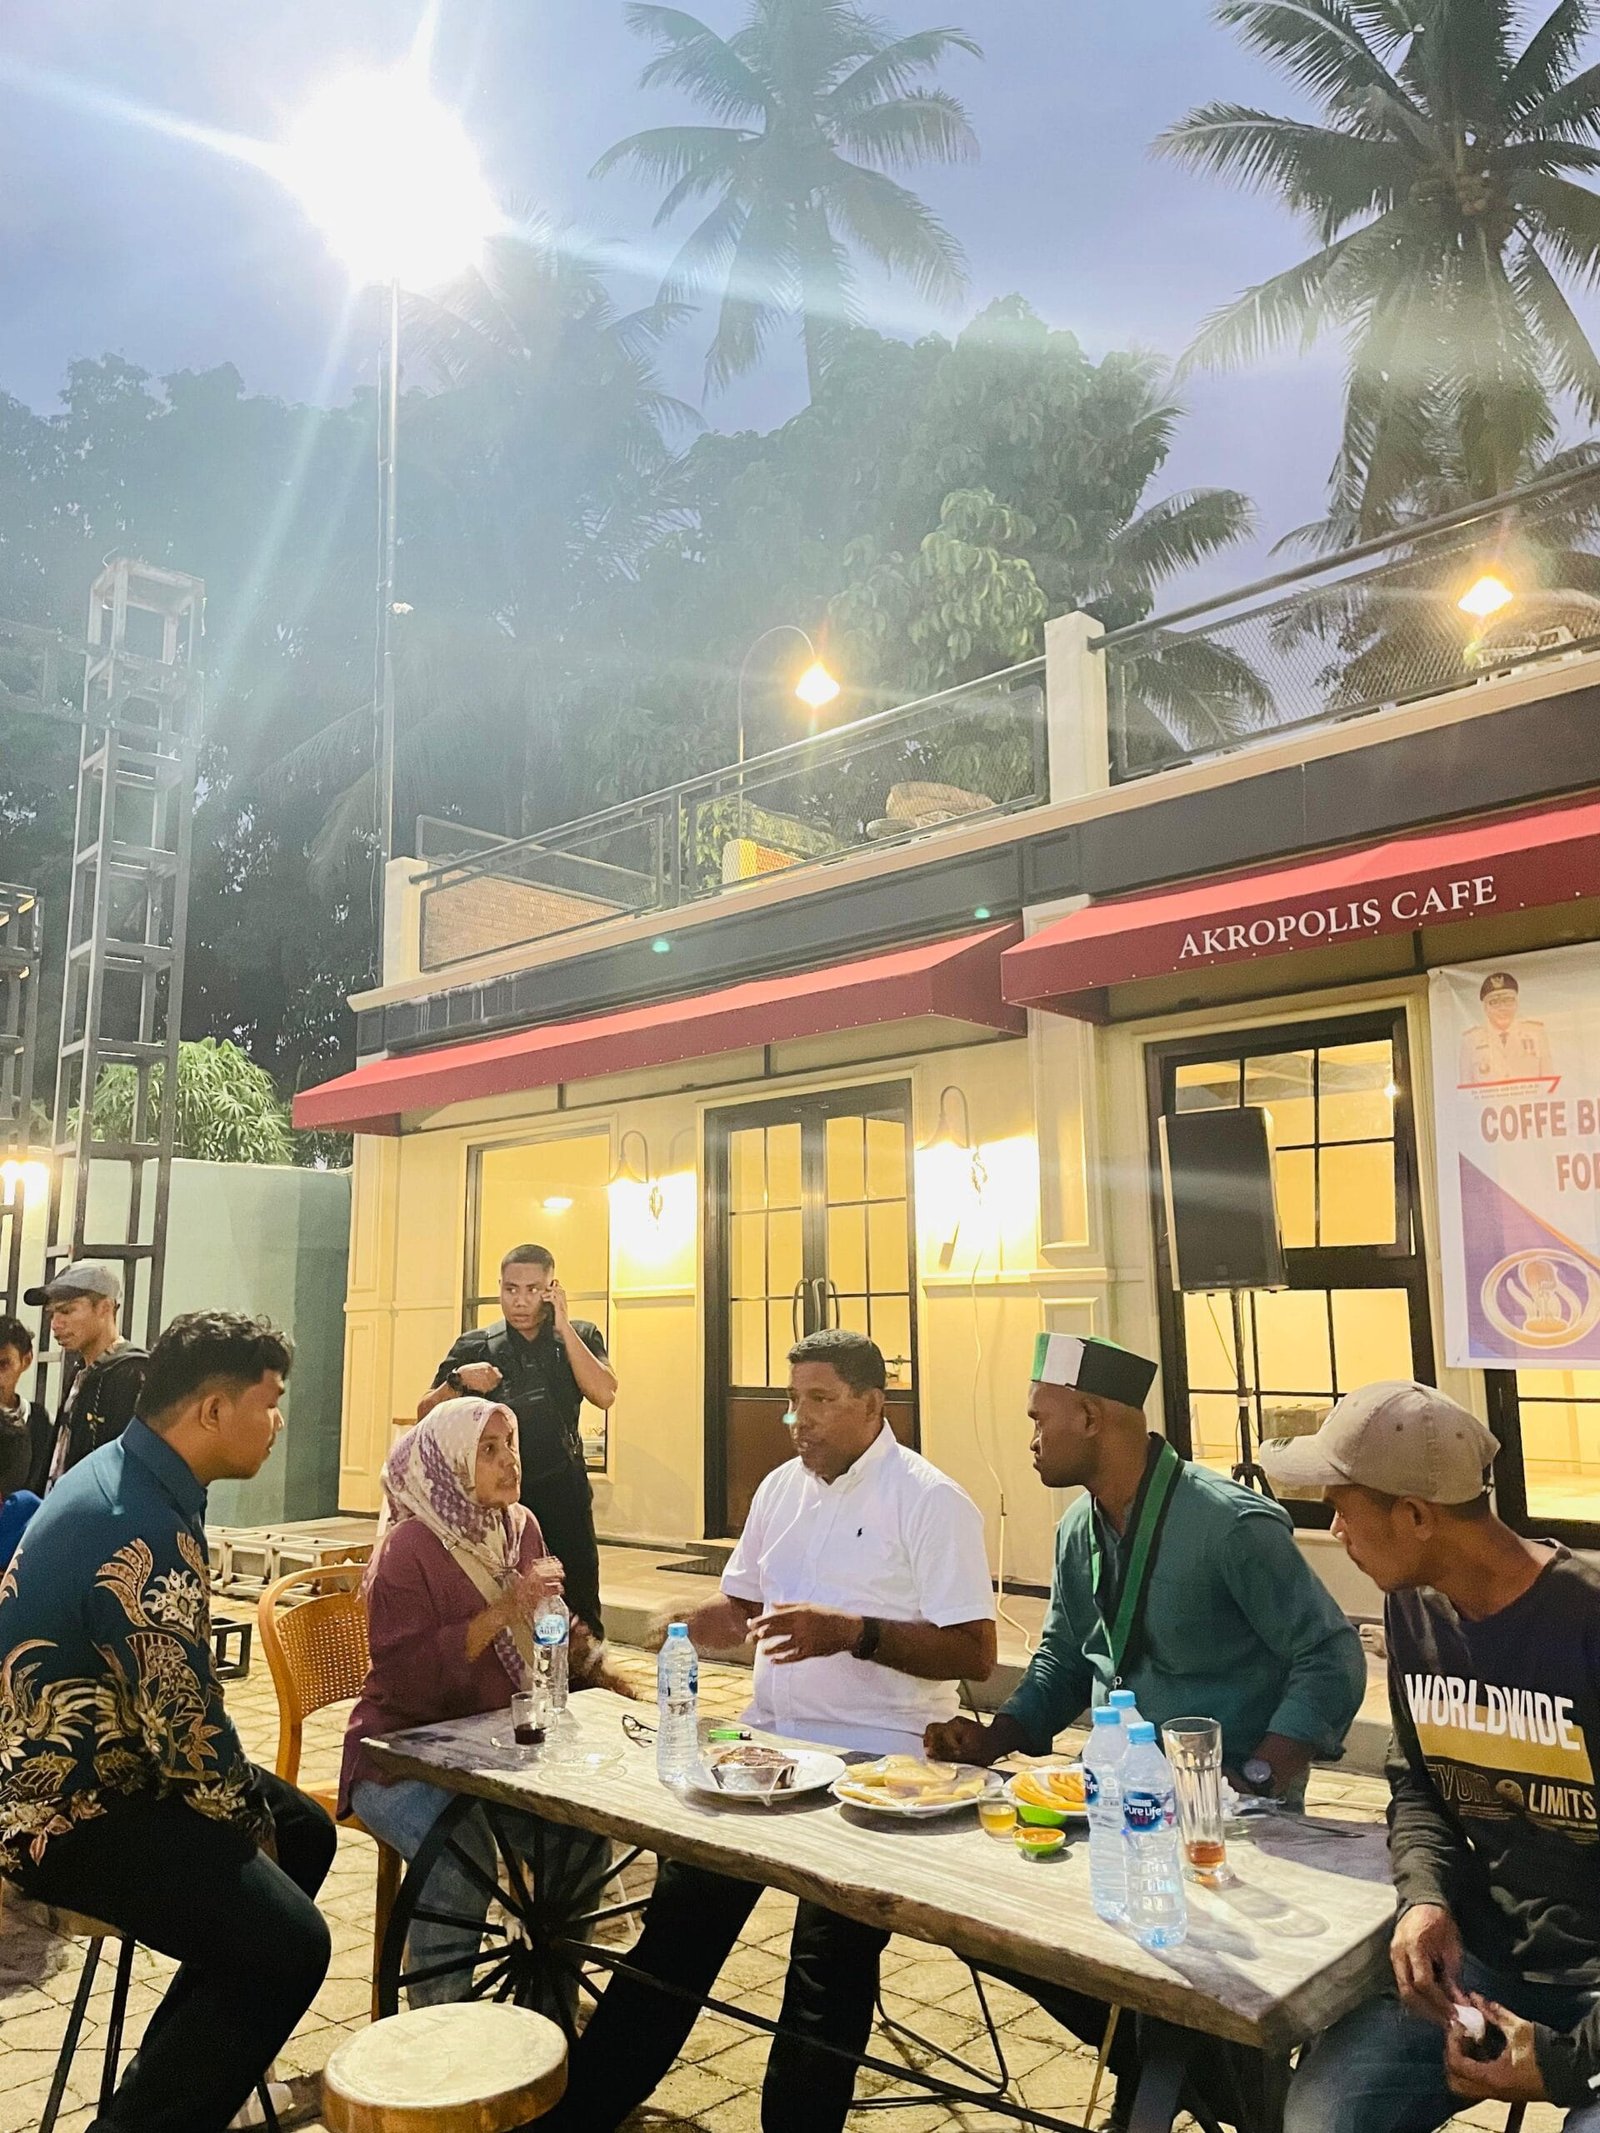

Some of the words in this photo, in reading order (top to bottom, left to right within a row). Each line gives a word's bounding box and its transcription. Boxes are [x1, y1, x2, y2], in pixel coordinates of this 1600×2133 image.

[1179, 898, 1381, 959] AKROPOLIS
[1391, 875, 1497, 919] CAFE
[1480, 1100, 1567, 1143] COFFE
[1577, 1098, 1600, 1135] B
[1404, 1673, 1581, 1750] WORLDWIDE
[1123, 1803, 1144, 1816] Pure
[1144, 1806, 1162, 1820] Life
[1529, 1782, 1598, 1820] LIMITS
